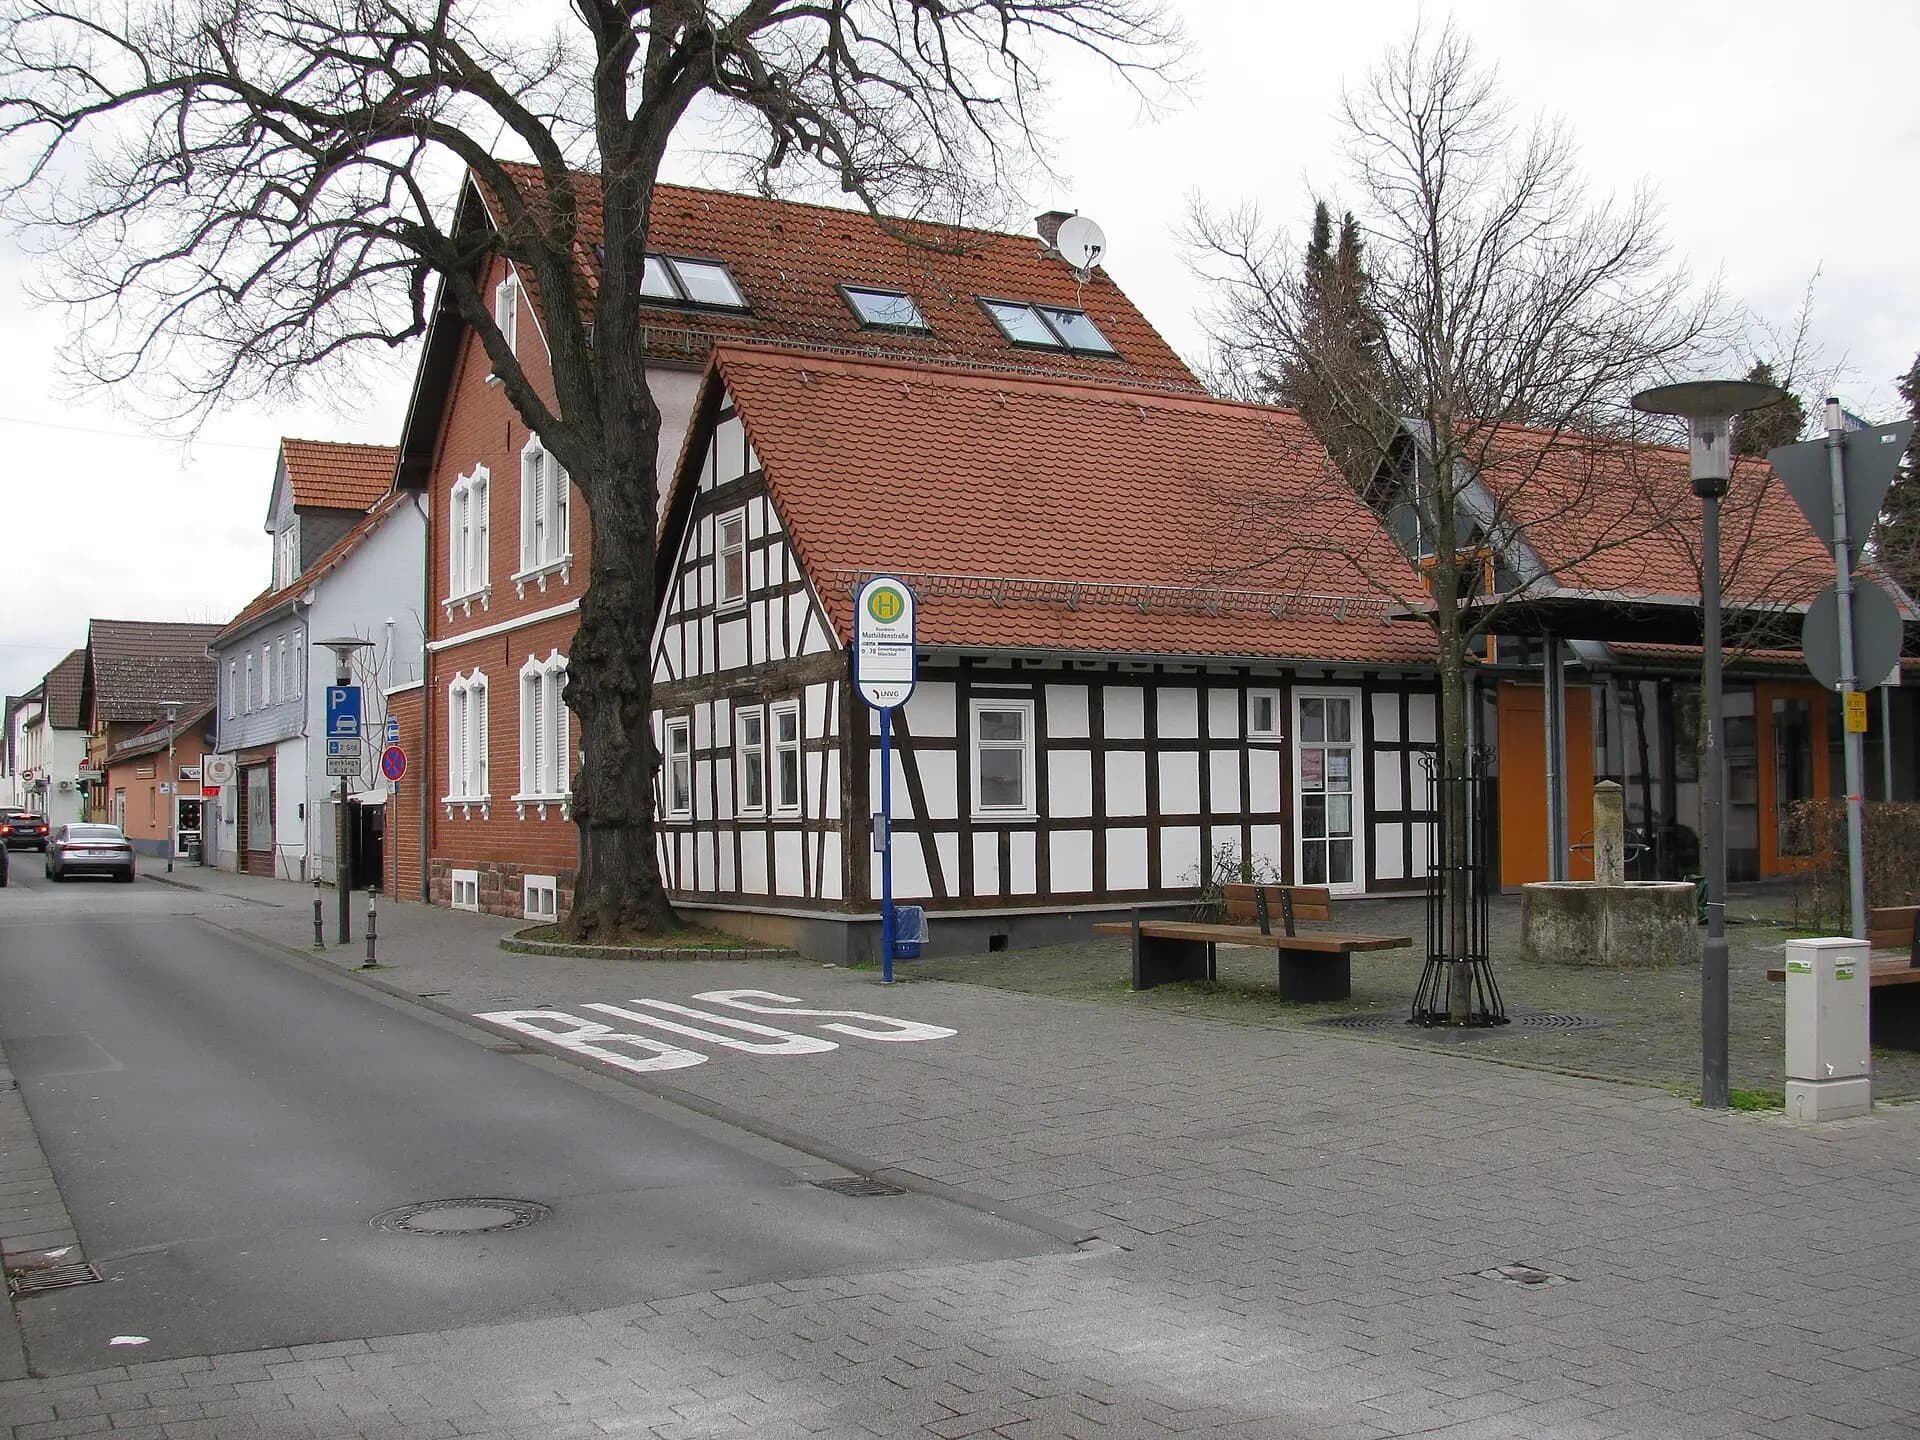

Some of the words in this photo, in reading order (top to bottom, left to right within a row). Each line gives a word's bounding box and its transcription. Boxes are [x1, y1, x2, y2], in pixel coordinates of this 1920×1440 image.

[878, 594, 893, 616] H
[862, 631, 909, 639] Mathildenstraße
[332, 689, 347, 710] P
[472, 989, 958, 1072] BUS
